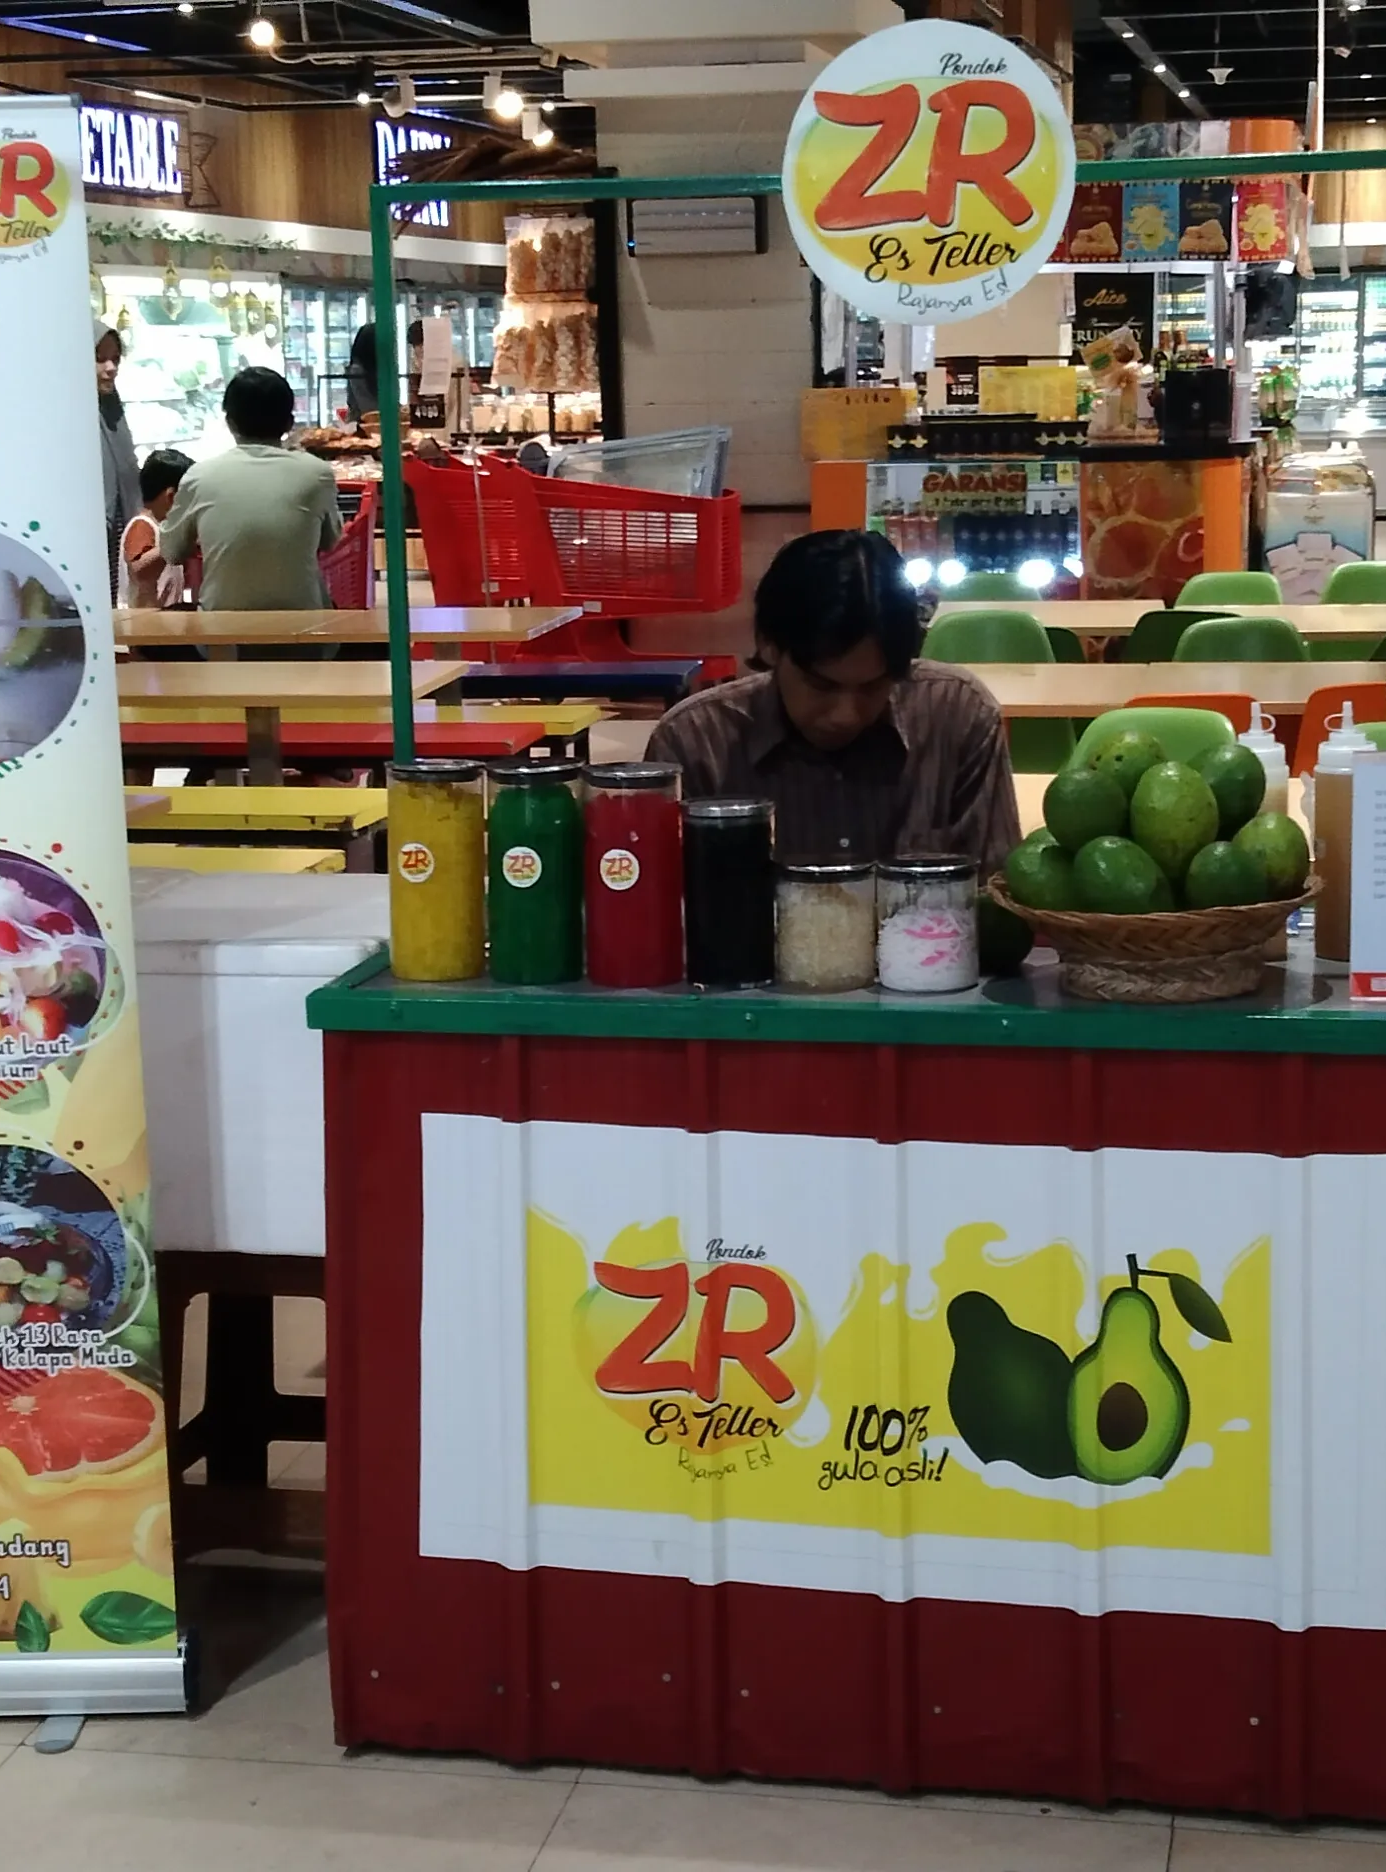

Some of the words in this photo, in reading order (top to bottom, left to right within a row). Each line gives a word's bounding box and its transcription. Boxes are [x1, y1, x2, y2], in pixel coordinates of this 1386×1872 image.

[939, 52, 1008, 76] Pondok
[79, 106, 183, 194] ETABLE
[813, 80, 1036, 232] ZR
[0, 220, 53, 243] Teller
[864, 233, 915, 284] Es
[924, 231, 1022, 277] Teller
[898, 282, 973, 315] Rajanya
[401, 850, 428, 869] ZR
[507, 855, 535, 875] ZR
[604, 857, 632, 876] ZR
[22, 1035, 71, 1055] Laut
[706, 1238, 767, 1260] Pondok
[53, 1325, 104, 1346] Rasa
[594, 1261, 796, 1404] ZR
[5, 1348, 73, 1374] Kelapa
[80, 1348, 135, 1367] Muda
[644, 1400, 689, 1445] Es
[693, 1403, 783, 1448] Teller
[844, 1404, 931, 1457] 100%
[818, 1449, 880, 1491] gula
[884, 1447, 950, 1488] asli!
